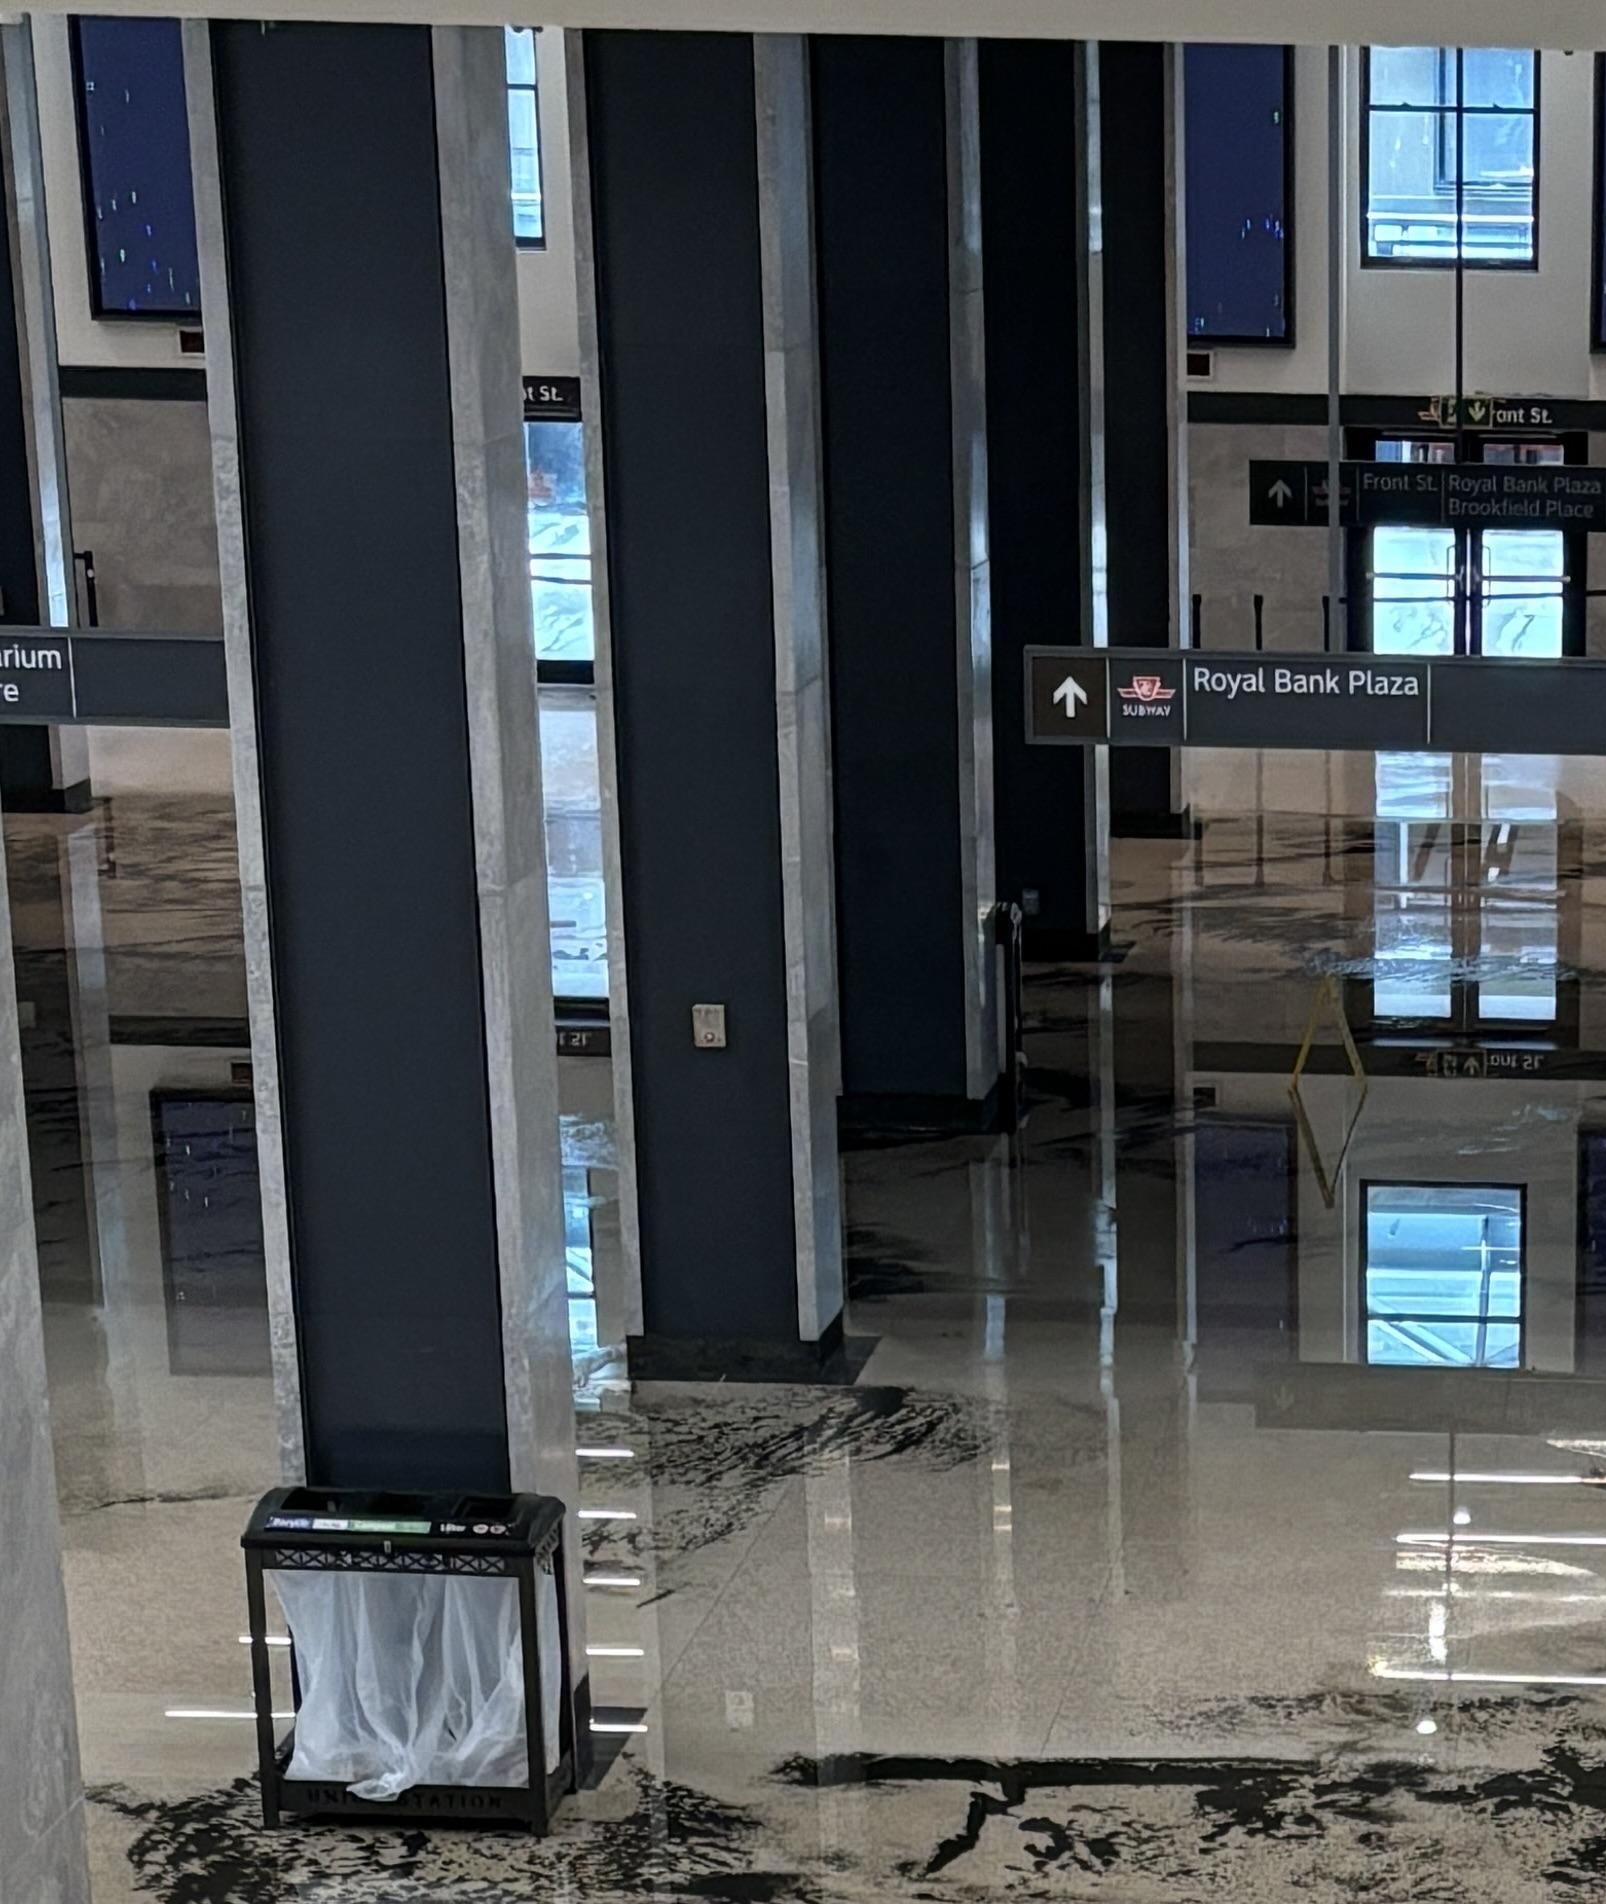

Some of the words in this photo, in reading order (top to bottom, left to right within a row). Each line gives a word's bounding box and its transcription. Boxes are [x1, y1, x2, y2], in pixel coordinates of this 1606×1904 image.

[1492, 407, 1526, 424] ont
[1363, 473, 1409, 490] Front
[1416, 475, 1439, 492] St.
[1450, 475, 1496, 496] Royal
[1504, 475, 1549, 493] Bank
[1554, 477, 1601, 494] Plaza
[1449, 499, 1540, 517] Brookfield
[1546, 500, 1594, 518] Place
[1193, 667, 1265, 700] Royal
[1274, 668, 1340, 694] Bank
[1349, 669, 1419, 696] Plaza
[1122, 703, 1171, 717] SUBWAY
